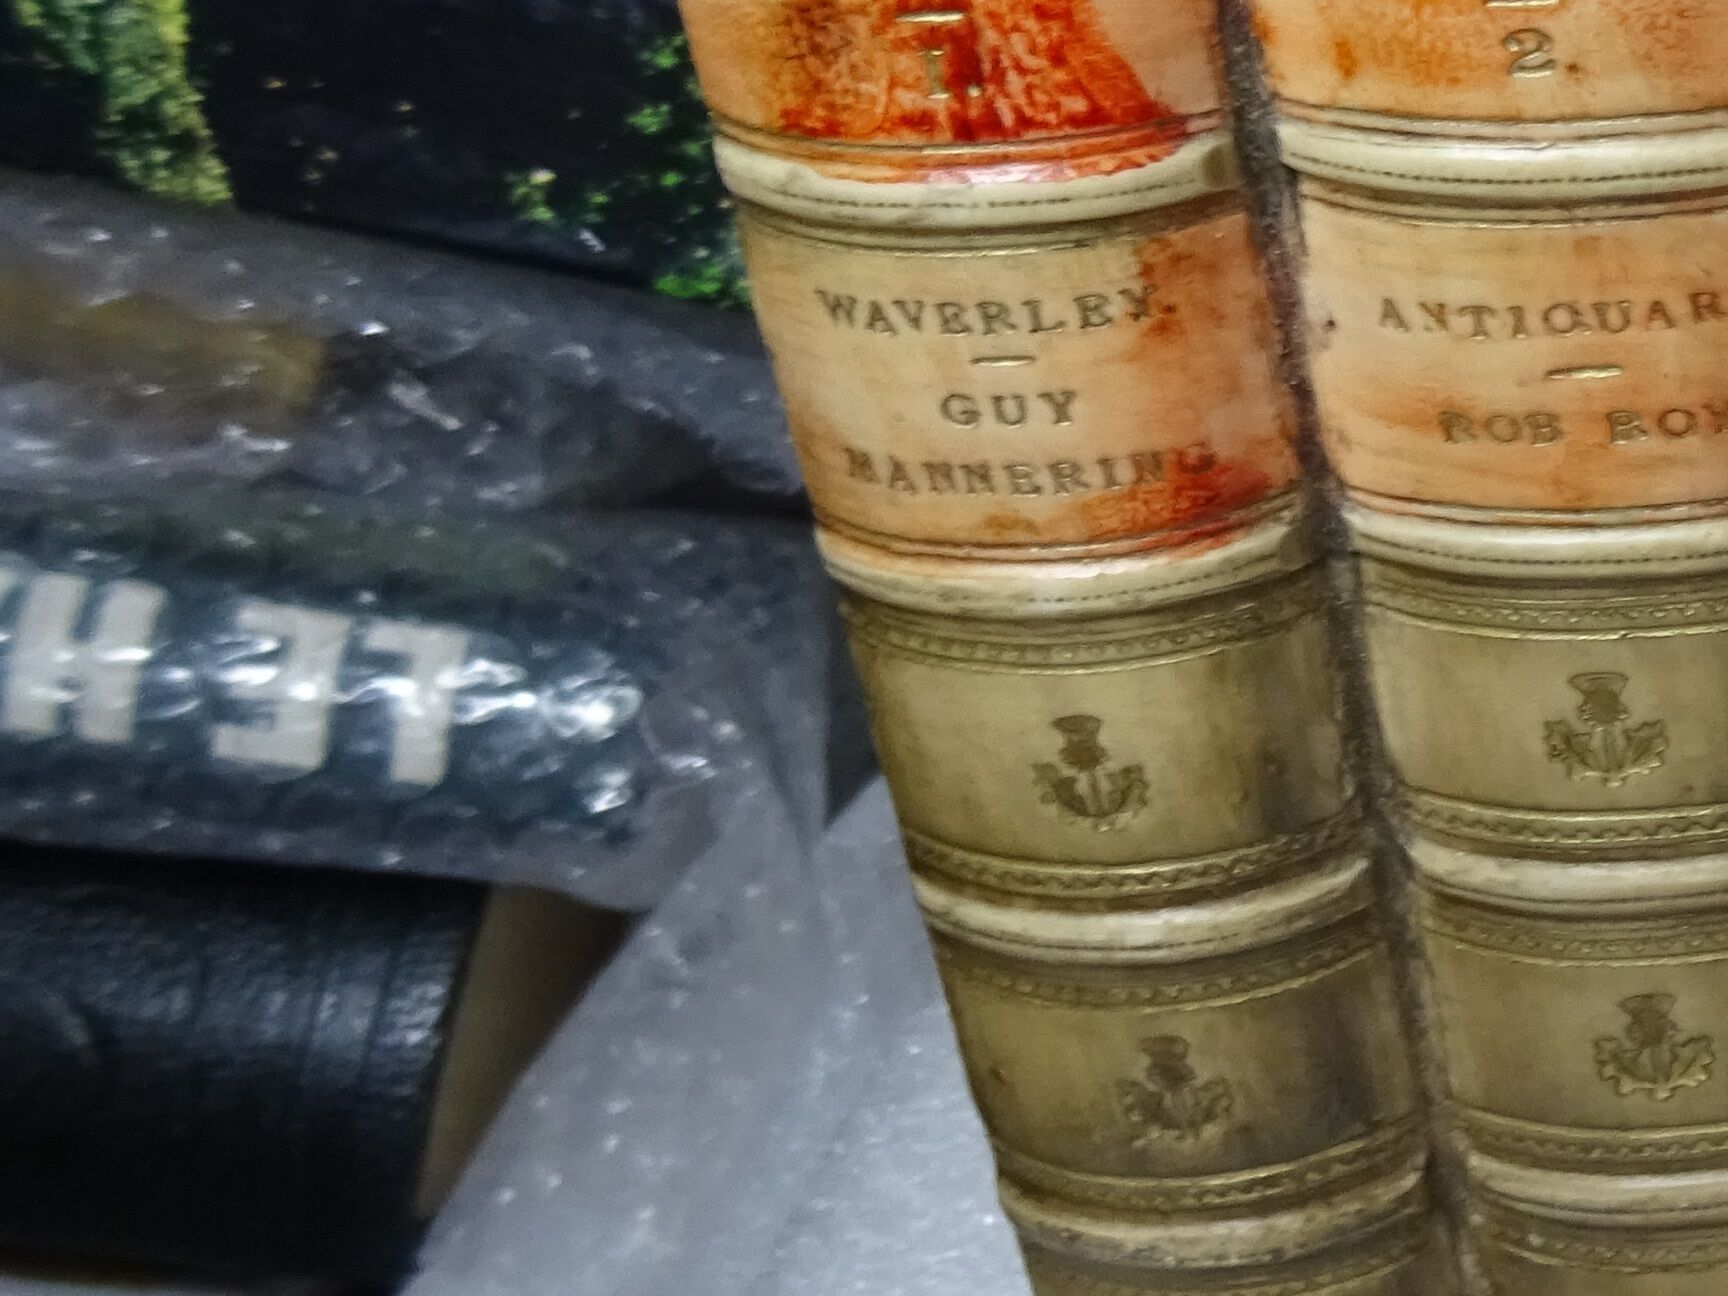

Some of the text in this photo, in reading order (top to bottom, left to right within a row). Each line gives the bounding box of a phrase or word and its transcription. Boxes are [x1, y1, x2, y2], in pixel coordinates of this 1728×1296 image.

[815, 282, 1156, 336] WAVERLEY
[940, 389, 1079, 428] GUY
[1437, 409, 1562, 448] ROB
[841, 442, 1218, 497] MANNERING
